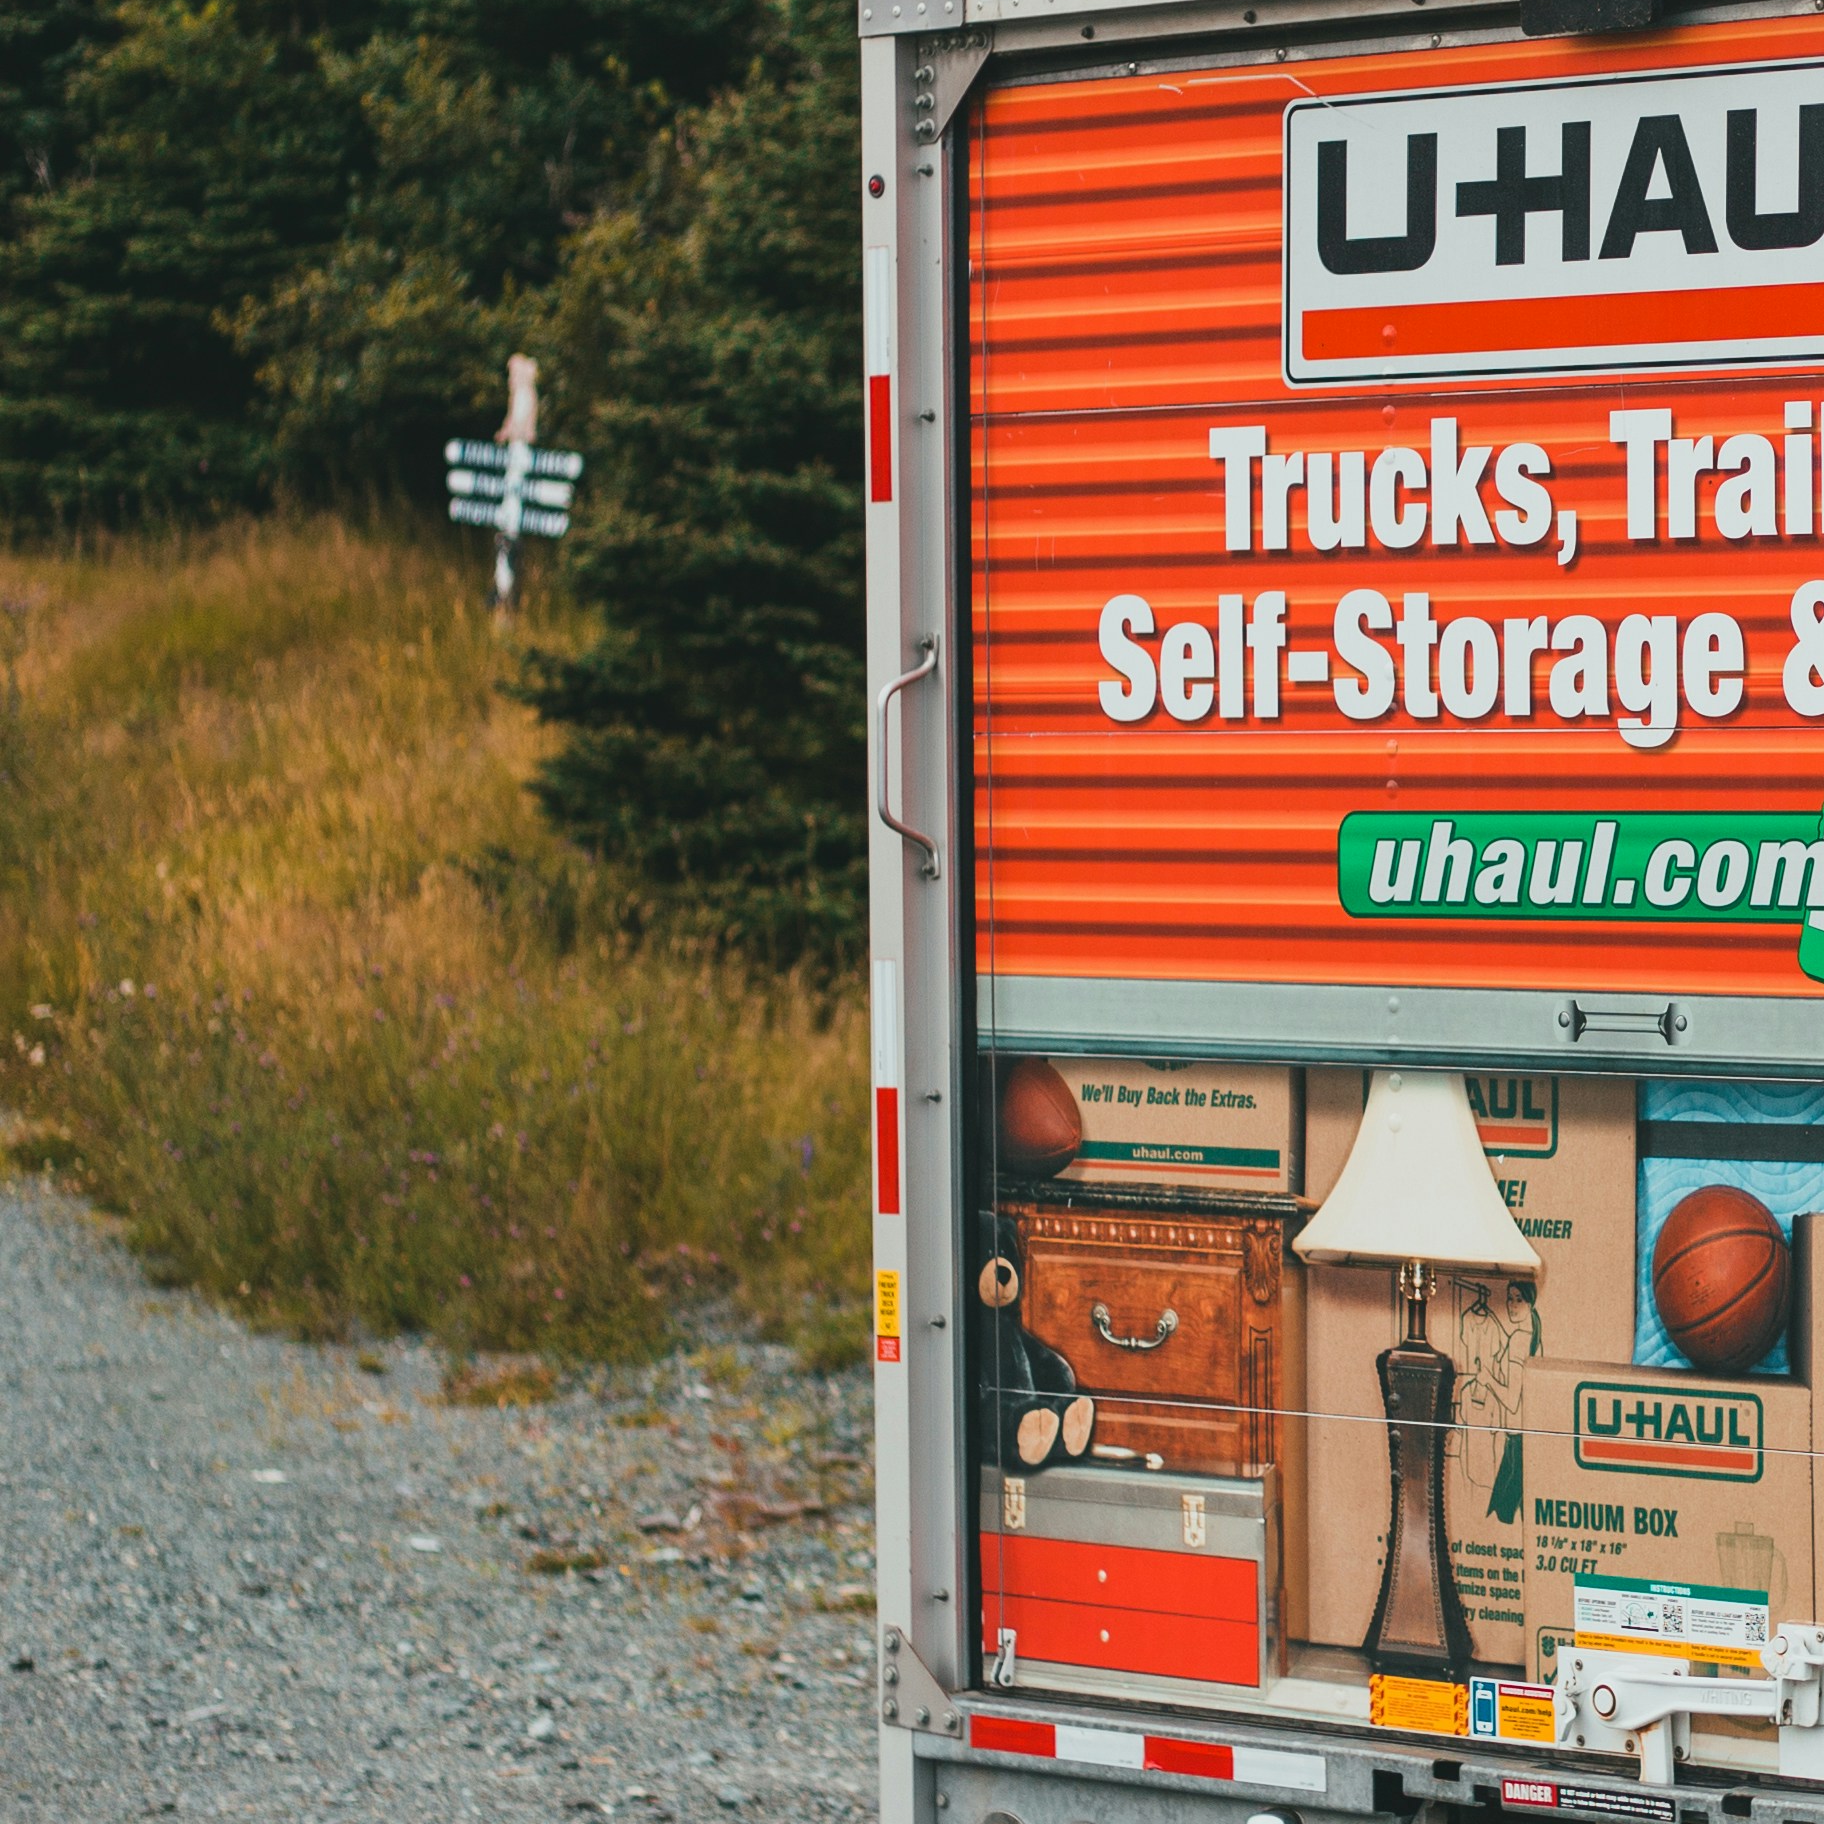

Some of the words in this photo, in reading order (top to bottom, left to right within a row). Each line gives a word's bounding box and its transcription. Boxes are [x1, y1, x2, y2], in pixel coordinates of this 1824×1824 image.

[1209, 417, 1577, 566] Trucks,
[1098, 587, 1745, 749] Self-Storage
[1081, 1084, 1114, 1103] We'll
[1117, 1085, 1142, 1107] Buy
[1146, 1086, 1180, 1106] Back
[1184, 1088, 1206, 1107] the
[1211, 1089, 1257, 1109] Extras.
[1464, 1077, 1545, 1120] AUL
[1132, 1146, 1204, 1161] uhaul.com
[1587, 1396, 1750, 1446] U-HAUL
[1535, 1497, 1625, 1533] MEDIUM
[1633, 1507, 1679, 1538] BOX
[1451, 1540, 1462, 1553] of
[1466, 1541, 1497, 1557] closet
[1500, 1546, 1524, 1561] spac
[1535, 1535, 1548, 1548] 18
[1570, 1540, 1576, 1551] x
[1580, 1539, 1597, 1553] 18"
[1600, 1544, 1606, 1554] x
[1609, 1542, 1627, 1556] 16"
[1456, 1563, 1484, 1579] items
[1487, 1569, 1500, 1580] on
[1502, 1568, 1519, 1583] the
[1535, 1555, 1556, 1572] 3.0
[1560, 1557, 1577, 1574] CU
[1581, 1559, 1598, 1575] FT
[1457, 1581, 1486, 1597] imize
[1489, 1586, 1521, 1601] space
[1462, 1604, 1476, 1621] ry
[1479, 1606, 1524, 1627] cleaning
[1504, 1782, 1553, 1803] DANGER
